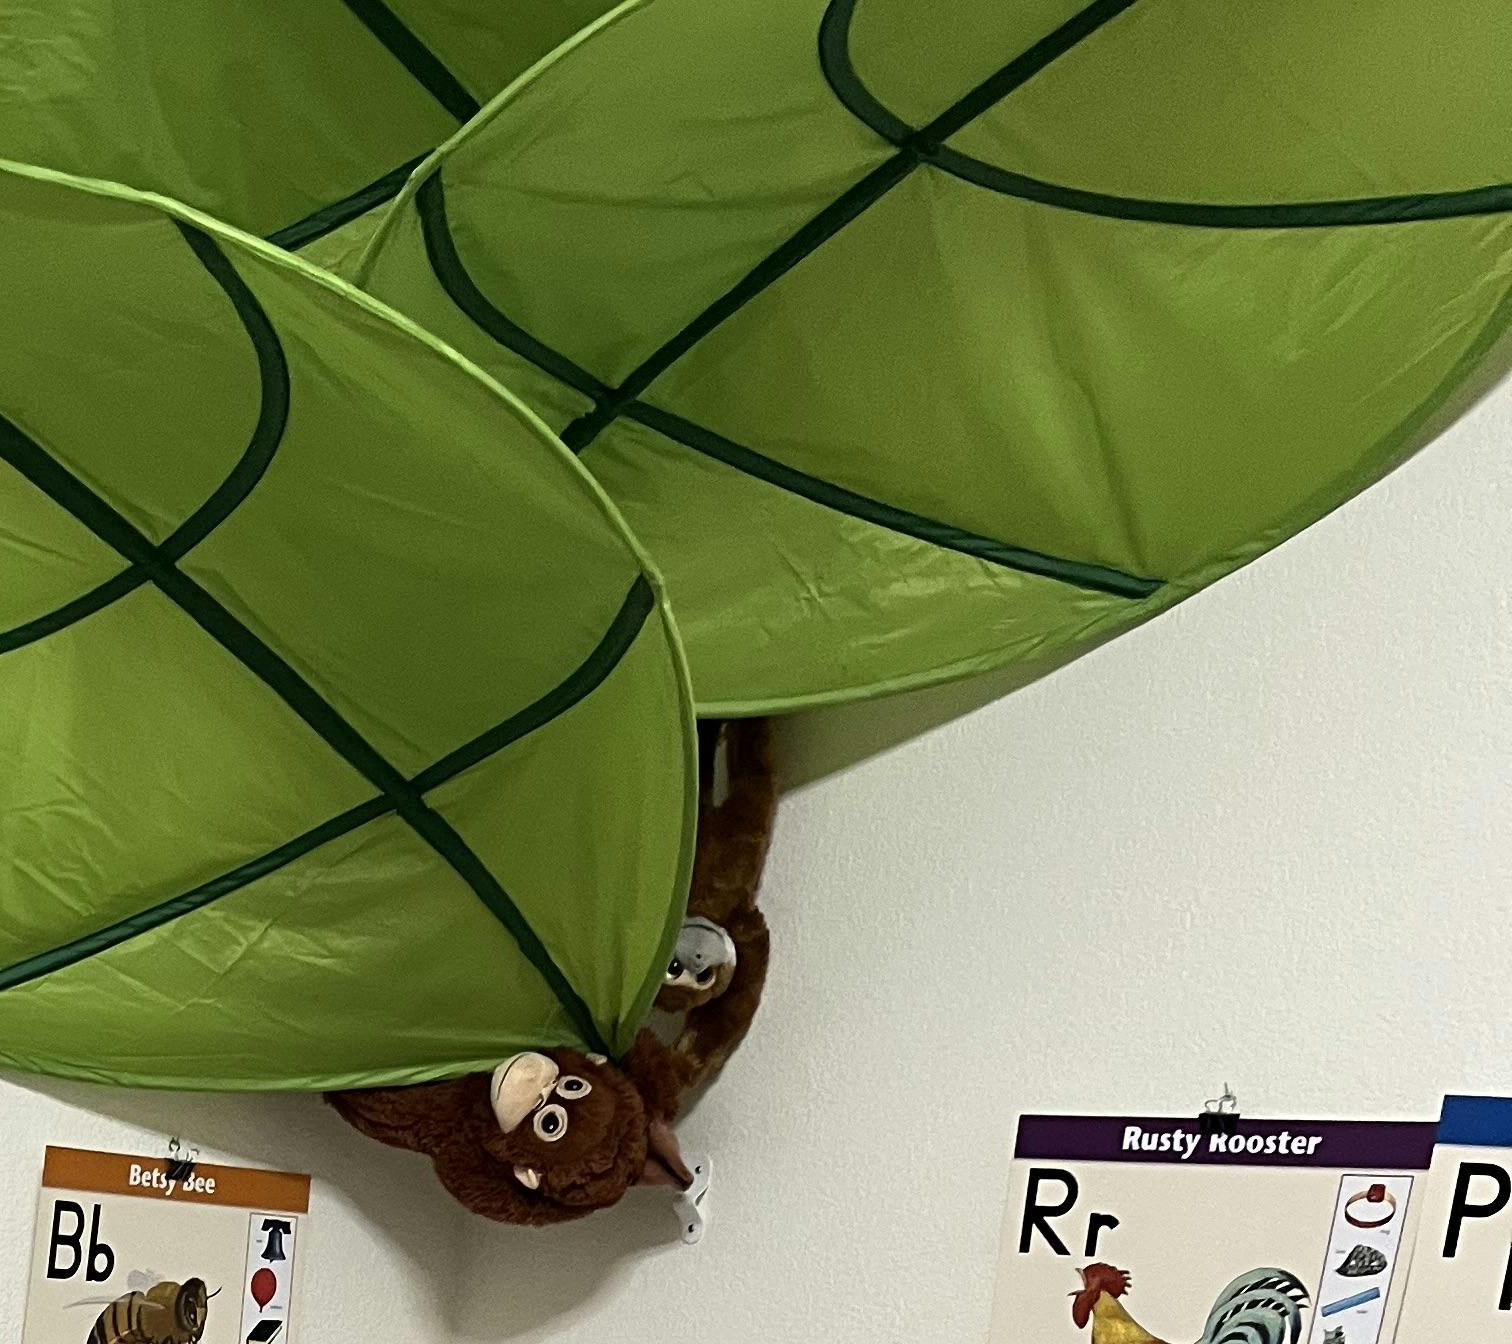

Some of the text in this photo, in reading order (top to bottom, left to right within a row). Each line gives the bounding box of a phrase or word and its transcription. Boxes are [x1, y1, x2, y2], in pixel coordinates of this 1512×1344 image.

[1122, 1126, 1322, 1160] Rusty Rooster
[129, 1164, 215, 1195] Betsy Bee
[46, 1200, 115, 1282] Bb
[1019, 1168, 1119, 1257] Rr
